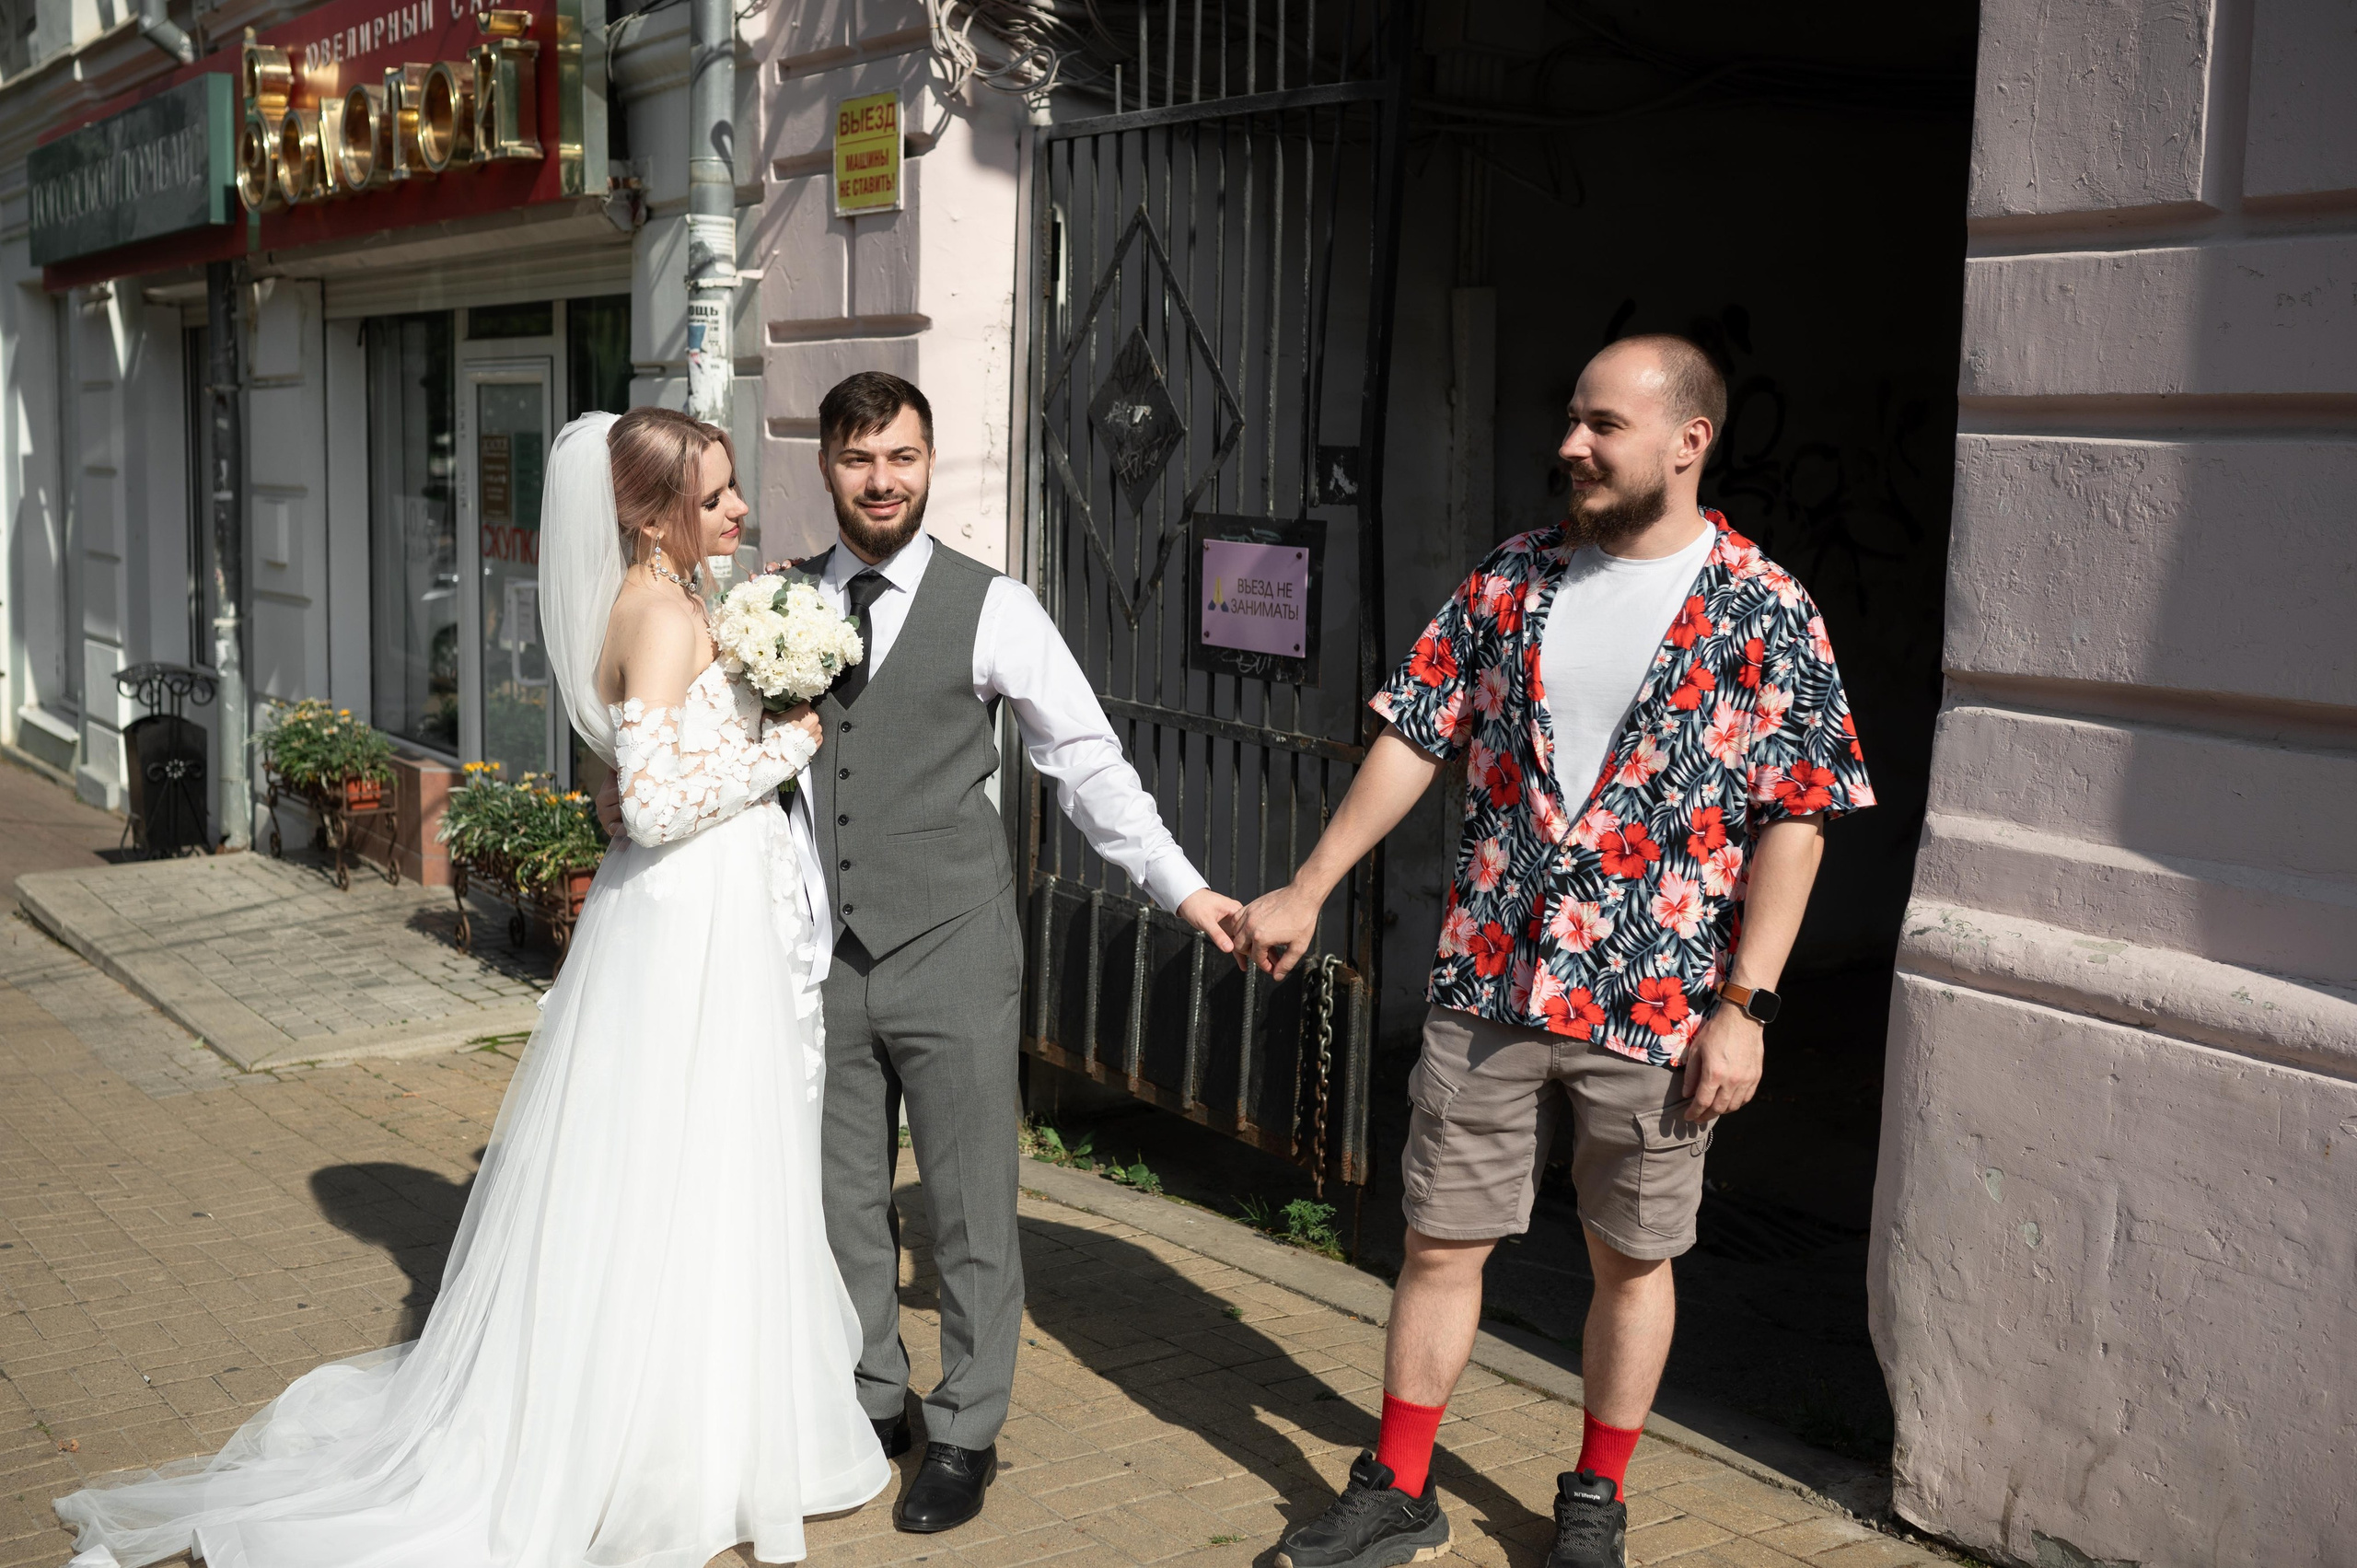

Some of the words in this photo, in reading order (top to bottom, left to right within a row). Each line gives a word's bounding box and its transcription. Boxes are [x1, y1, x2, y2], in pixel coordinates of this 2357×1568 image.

[839, 102, 896, 136] ВЫЕЗД
[845, 148, 889, 172] МАШИНЫ
[839, 180, 851, 198] НЕ
[852, 172, 896, 197] СТАВИТЬ!
[1237, 577, 1274, 599] ВЪЕЗД
[1277, 582, 1293, 598] НЕ
[1230, 598, 1299, 621] ЗАНИМАТЬ!
